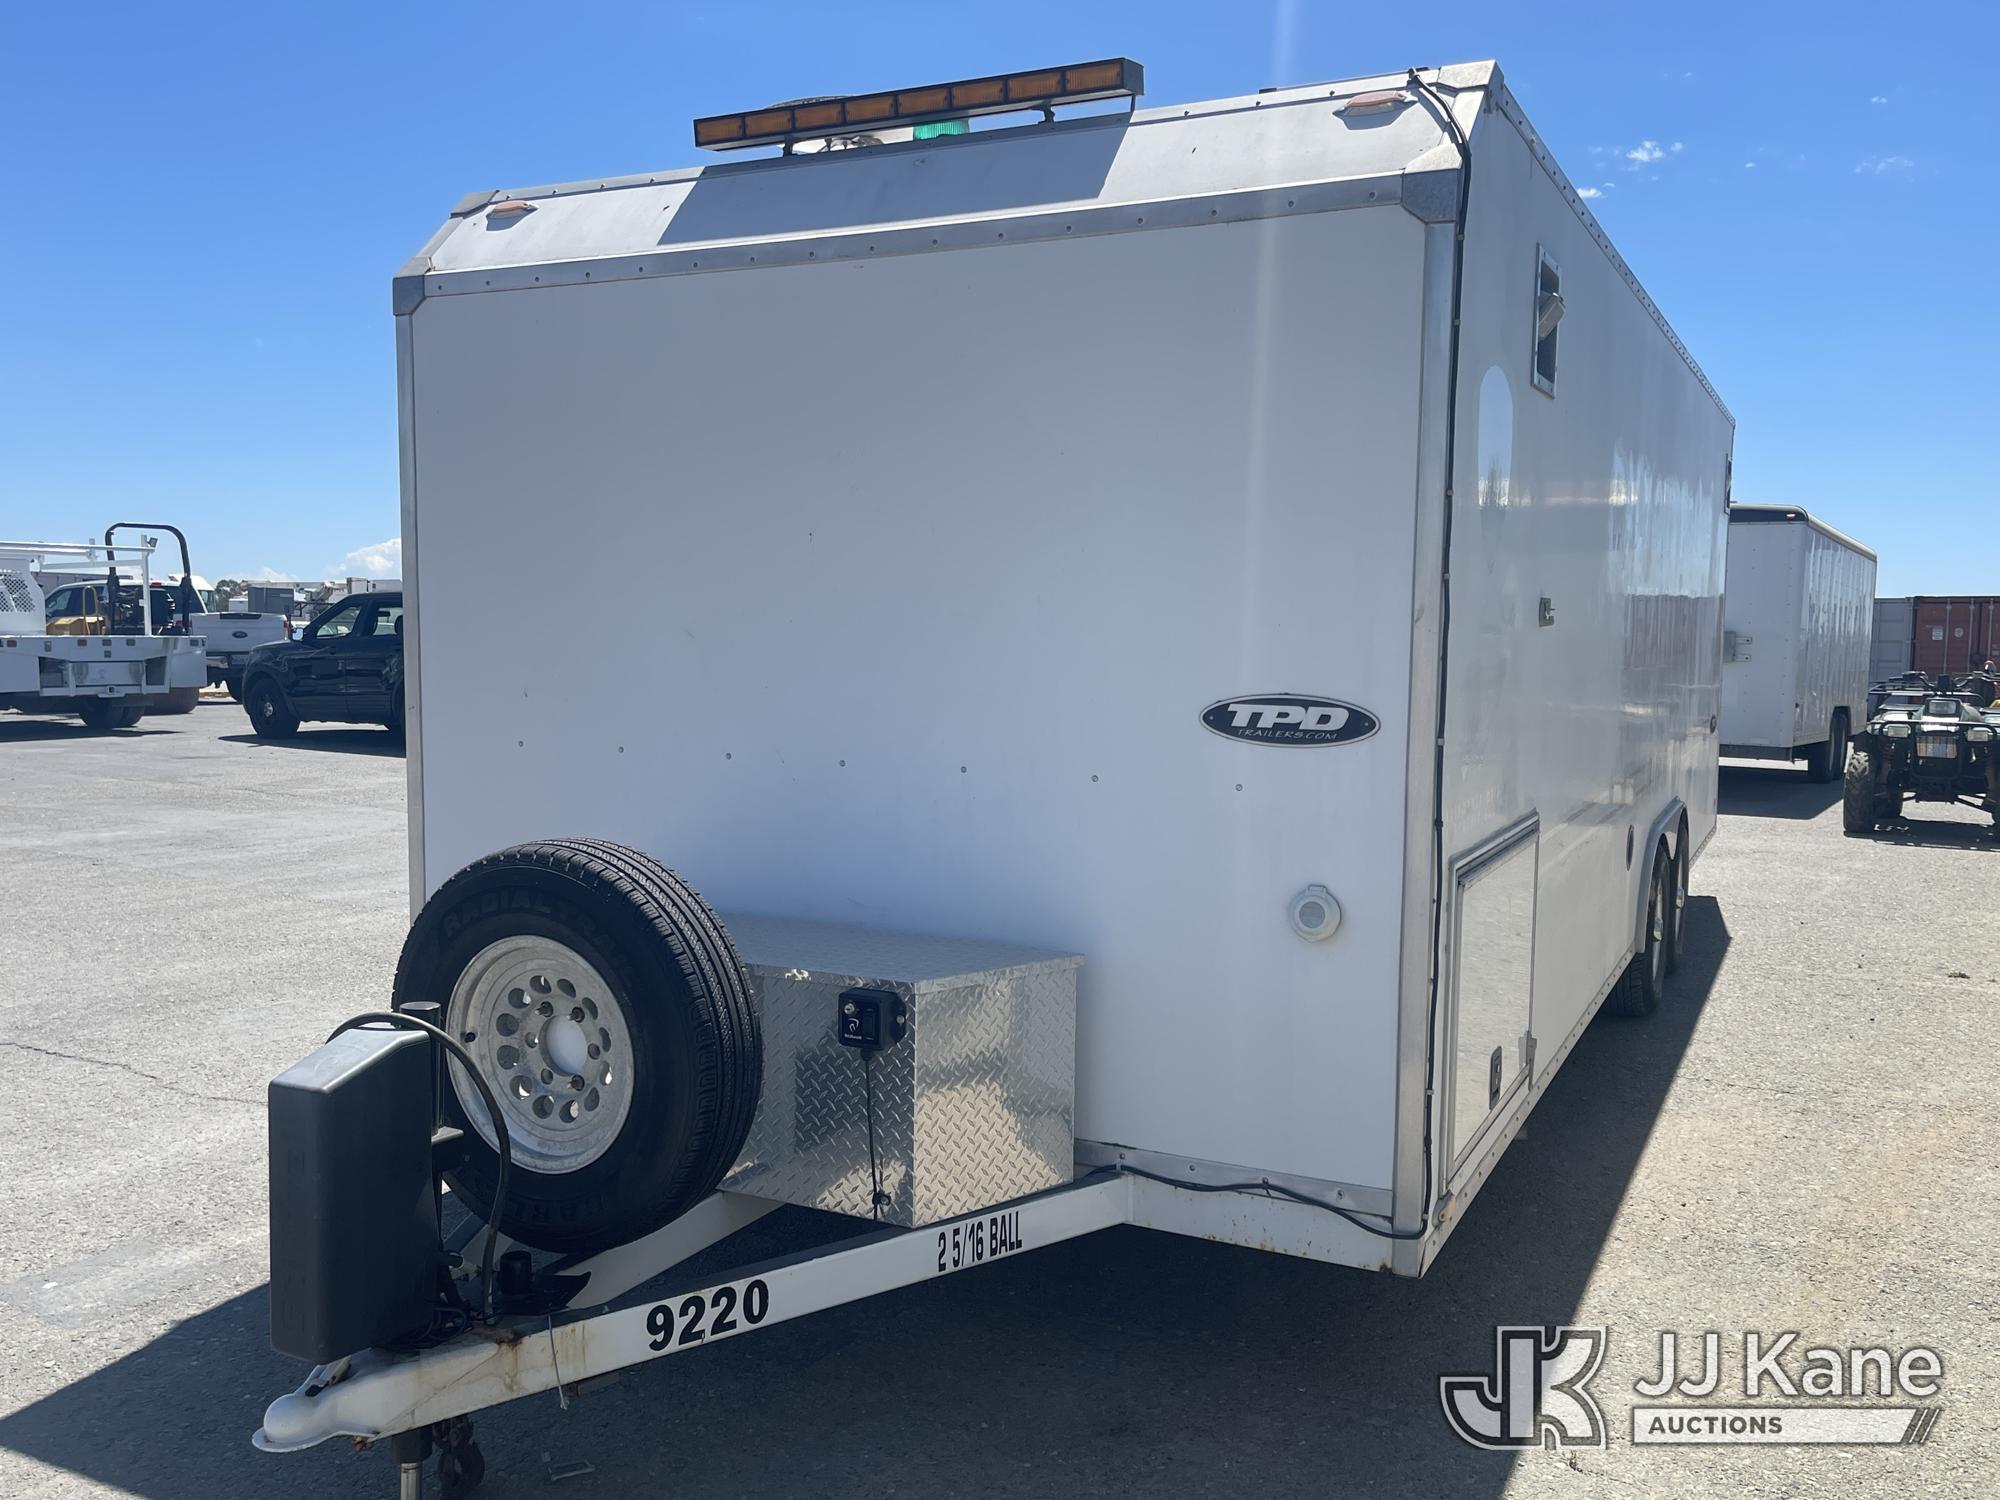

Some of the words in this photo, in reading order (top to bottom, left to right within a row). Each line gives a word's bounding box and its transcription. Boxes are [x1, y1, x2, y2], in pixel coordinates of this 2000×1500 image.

[1227, 703, 1350, 731] TPD
[937, 1231, 947, 1273] 2
[952, 1220, 984, 1268] 5/16
[989, 1211, 1023, 1258] BALL
[646, 1279, 770, 1352] 9220
